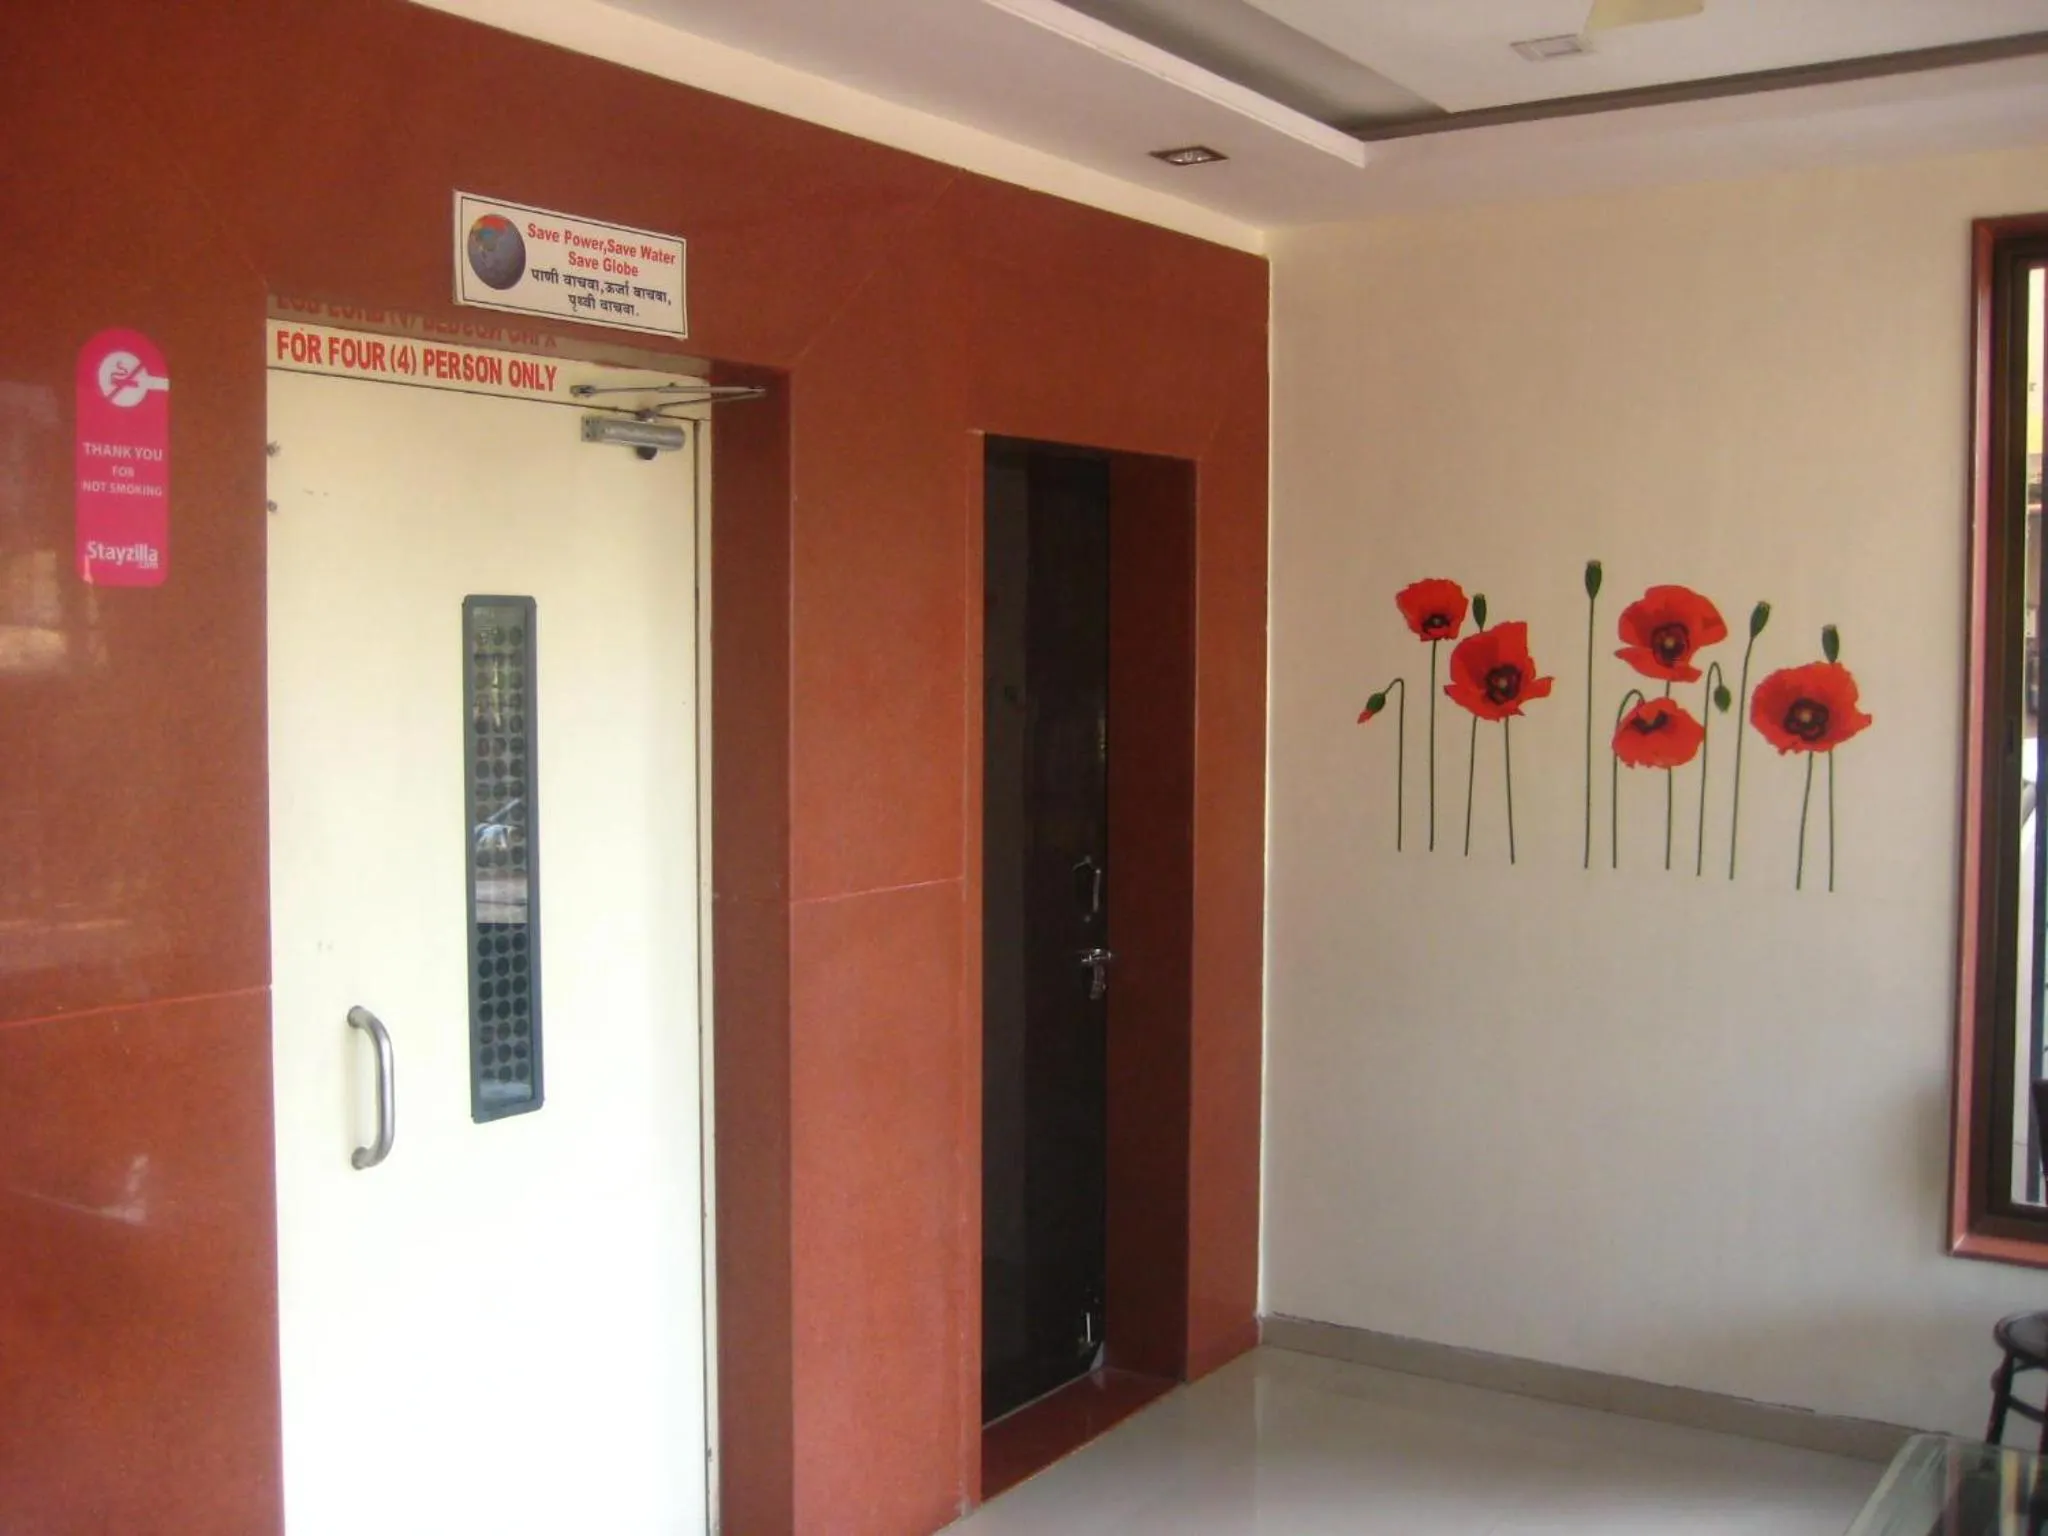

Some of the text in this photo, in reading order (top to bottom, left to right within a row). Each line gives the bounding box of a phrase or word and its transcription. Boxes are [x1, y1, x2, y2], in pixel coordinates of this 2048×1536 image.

[527, 223, 560, 242] Save
[640, 245, 676, 264] Water
[568, 251, 640, 277] Save Globe
[531, 268, 559, 284] पाणी
[276, 330, 558, 391] FOR FOUR (4) PERSON ONLY
[82, 442, 163, 461] THANK YOU
[112, 466, 135, 478] FOR
[82, 480, 162, 496] NOT SMOKING
[87, 541, 159, 567] Stayzilla
